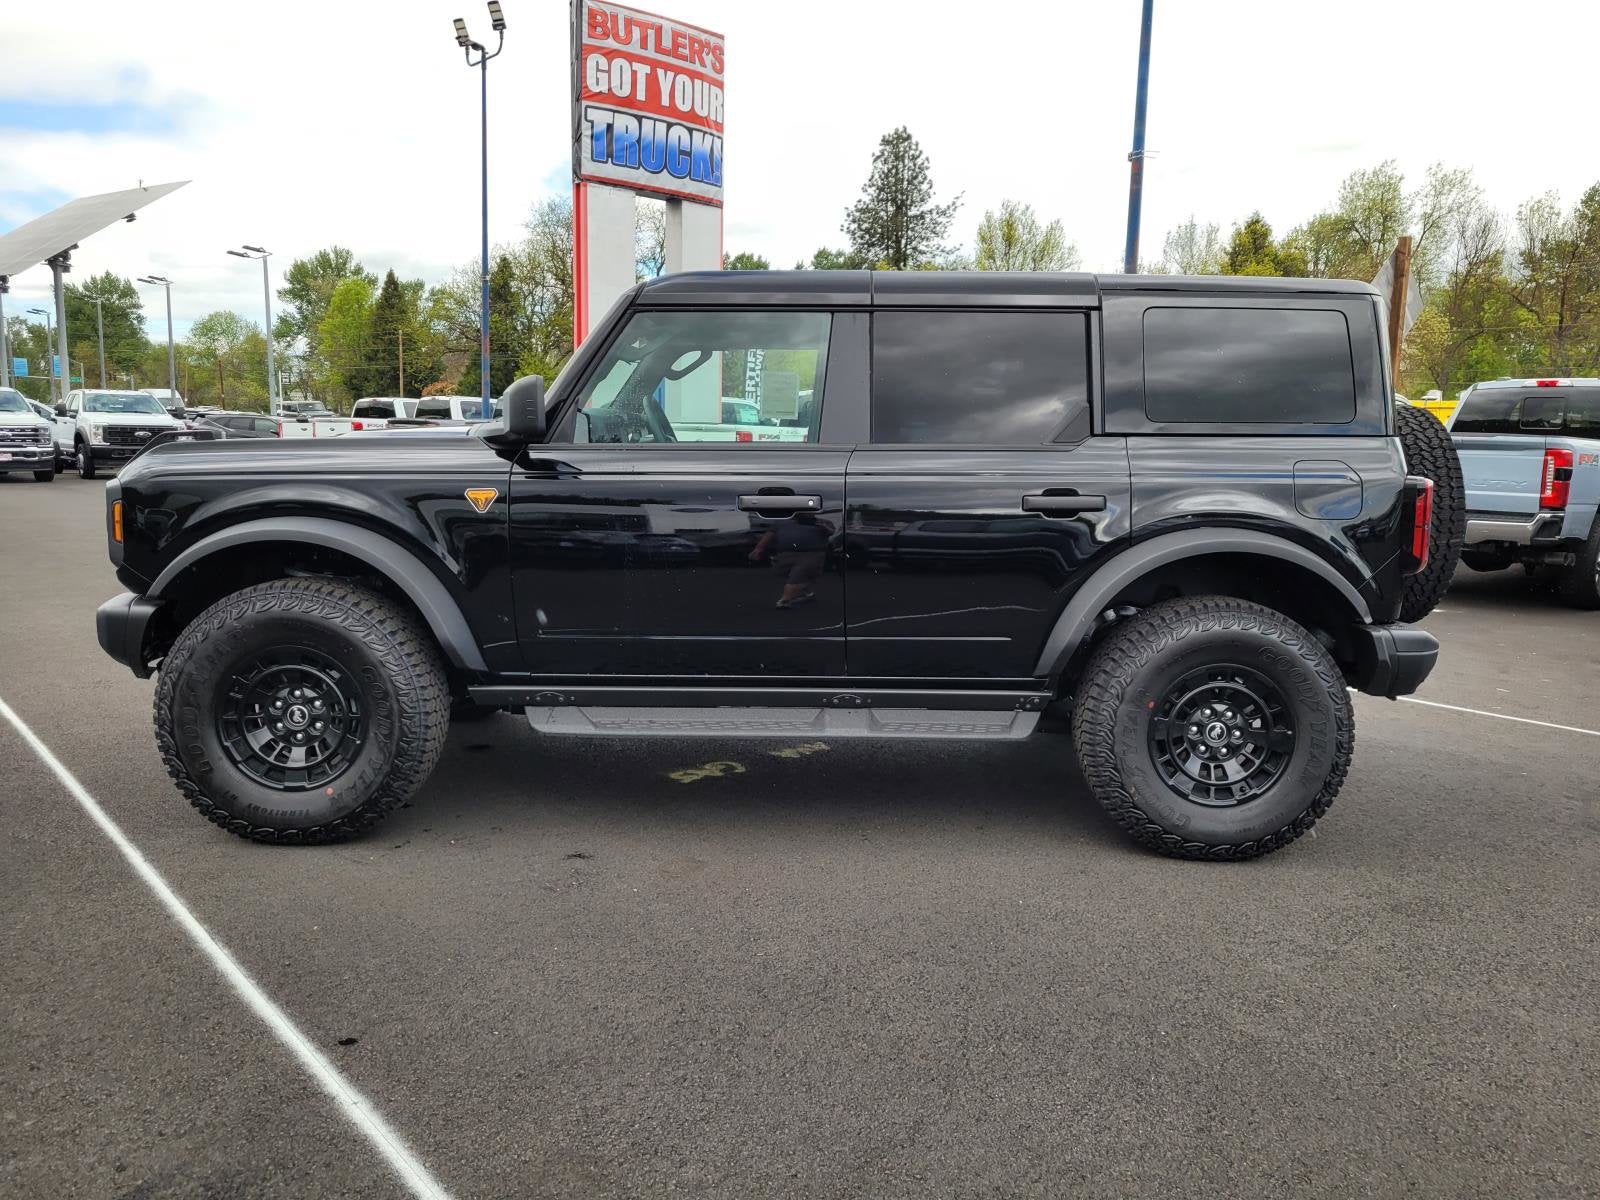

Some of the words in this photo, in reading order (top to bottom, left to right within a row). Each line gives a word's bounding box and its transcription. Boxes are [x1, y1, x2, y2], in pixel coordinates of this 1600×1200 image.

[587, 6, 724, 74] BUTLER'S
[586, 53, 651, 101] GOT
[656, 67, 724, 123] YOUR
[585, 105, 723, 187] TRUCK!
